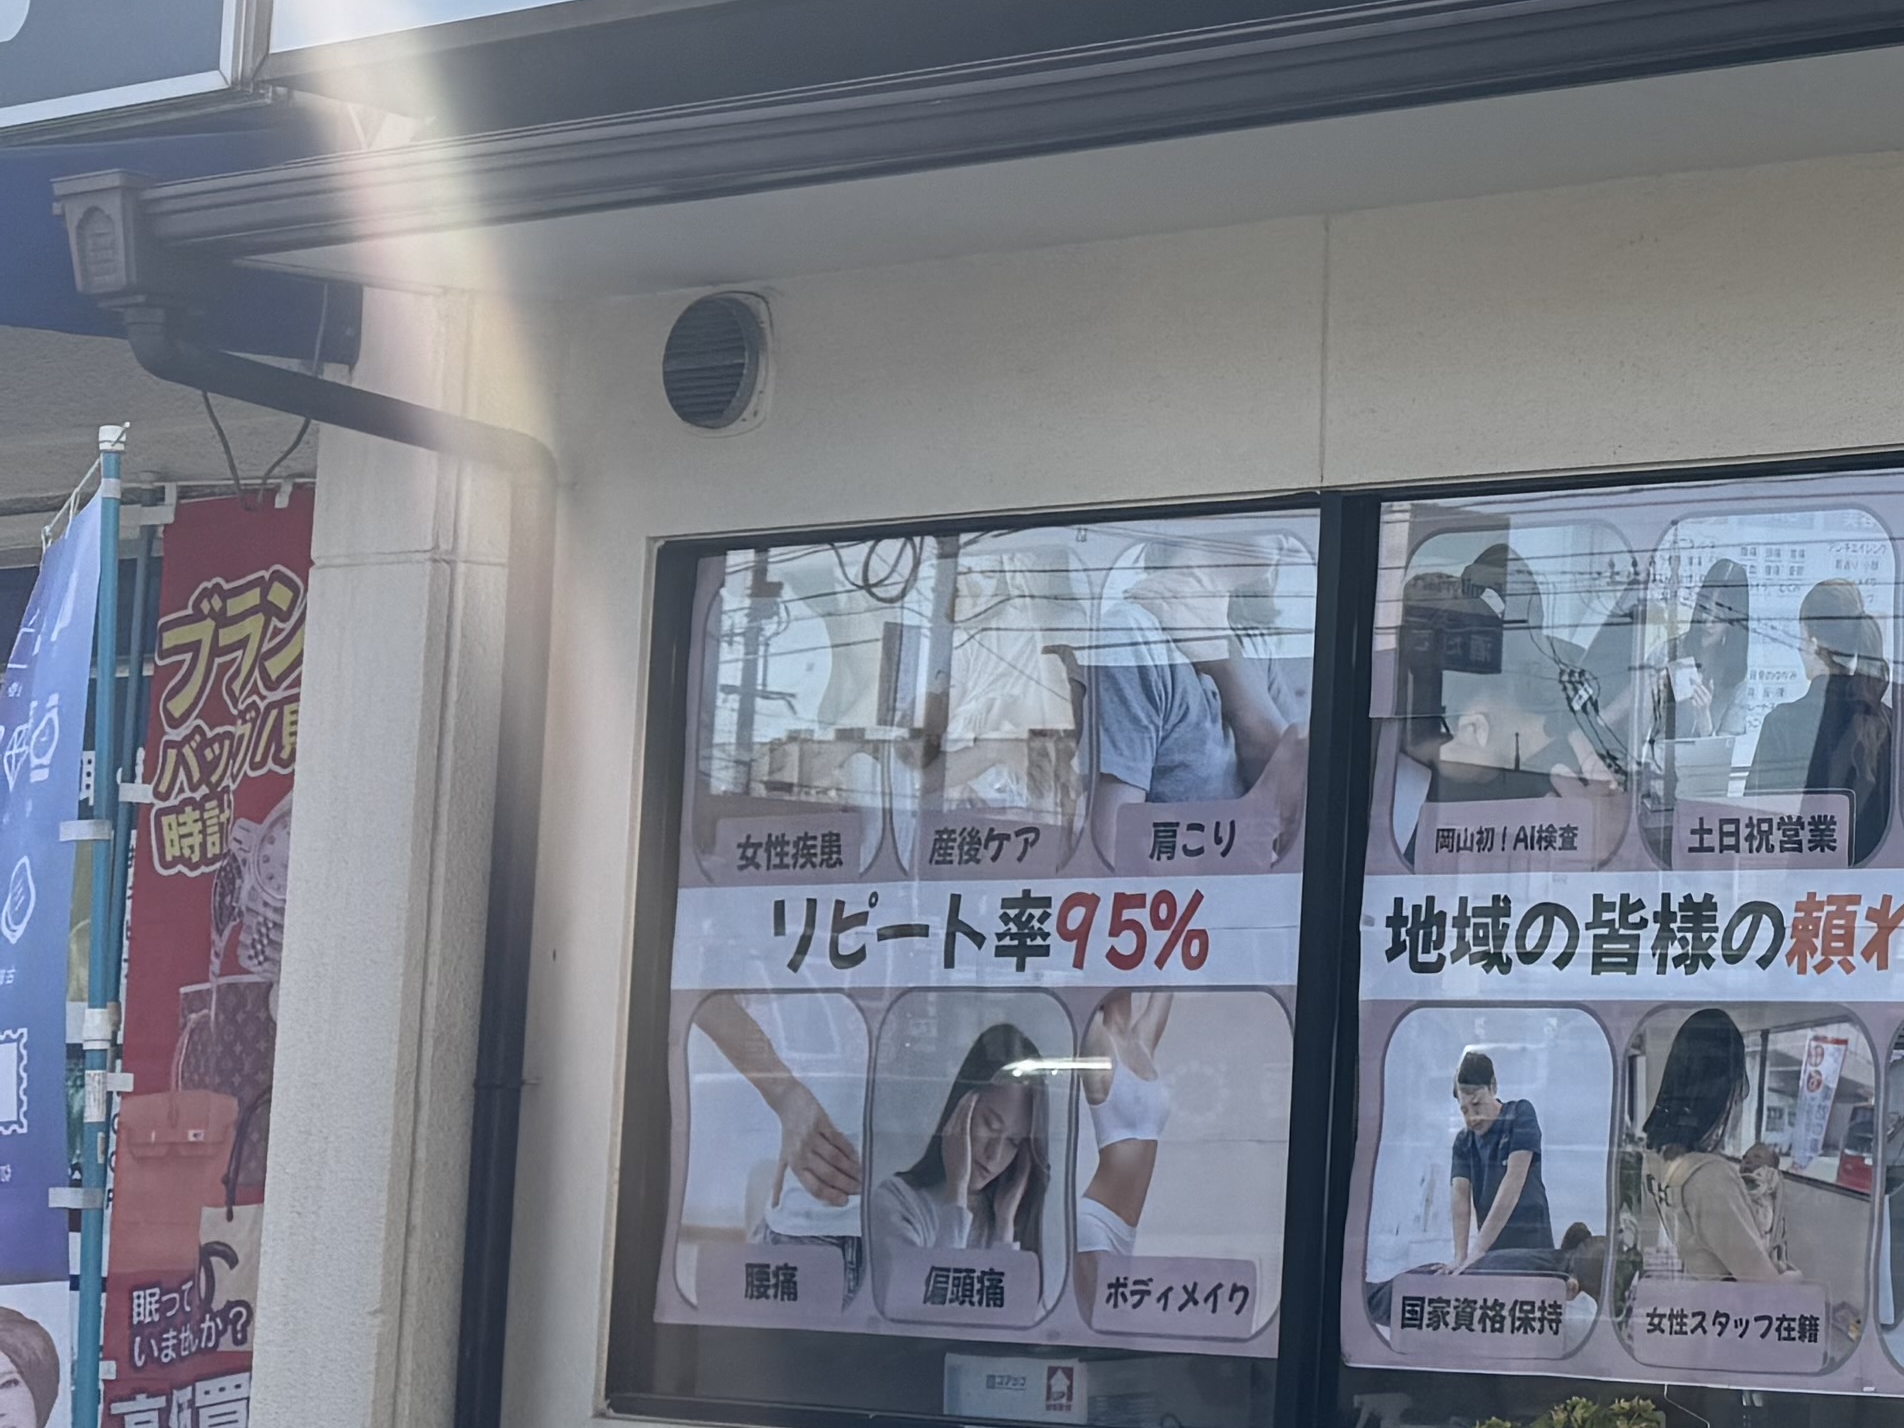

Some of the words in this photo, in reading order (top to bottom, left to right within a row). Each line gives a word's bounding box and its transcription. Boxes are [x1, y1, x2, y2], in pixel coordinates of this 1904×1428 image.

[161, 796, 232, 864] 時計
[736, 830, 845, 871] 女性疾患
[929, 824, 1042, 866] 産後ケア
[1148, 819, 1239, 863] 肩こり
[1687, 815, 1839, 856] 土日祝営業
[771, 887, 1210, 973] リピート率95%
[132, 1280, 194, 1325] 眠って
[744, 1263, 799, 1303] 腰痛
[922, 1264, 1006, 1310] 偏頭痛
[1104, 1276, 1251, 1317] ボディメイク
[1400, 1295, 1563, 1337] 国家資格保持
[1645, 1308, 1821, 1345] 女性スタッフ在籍
